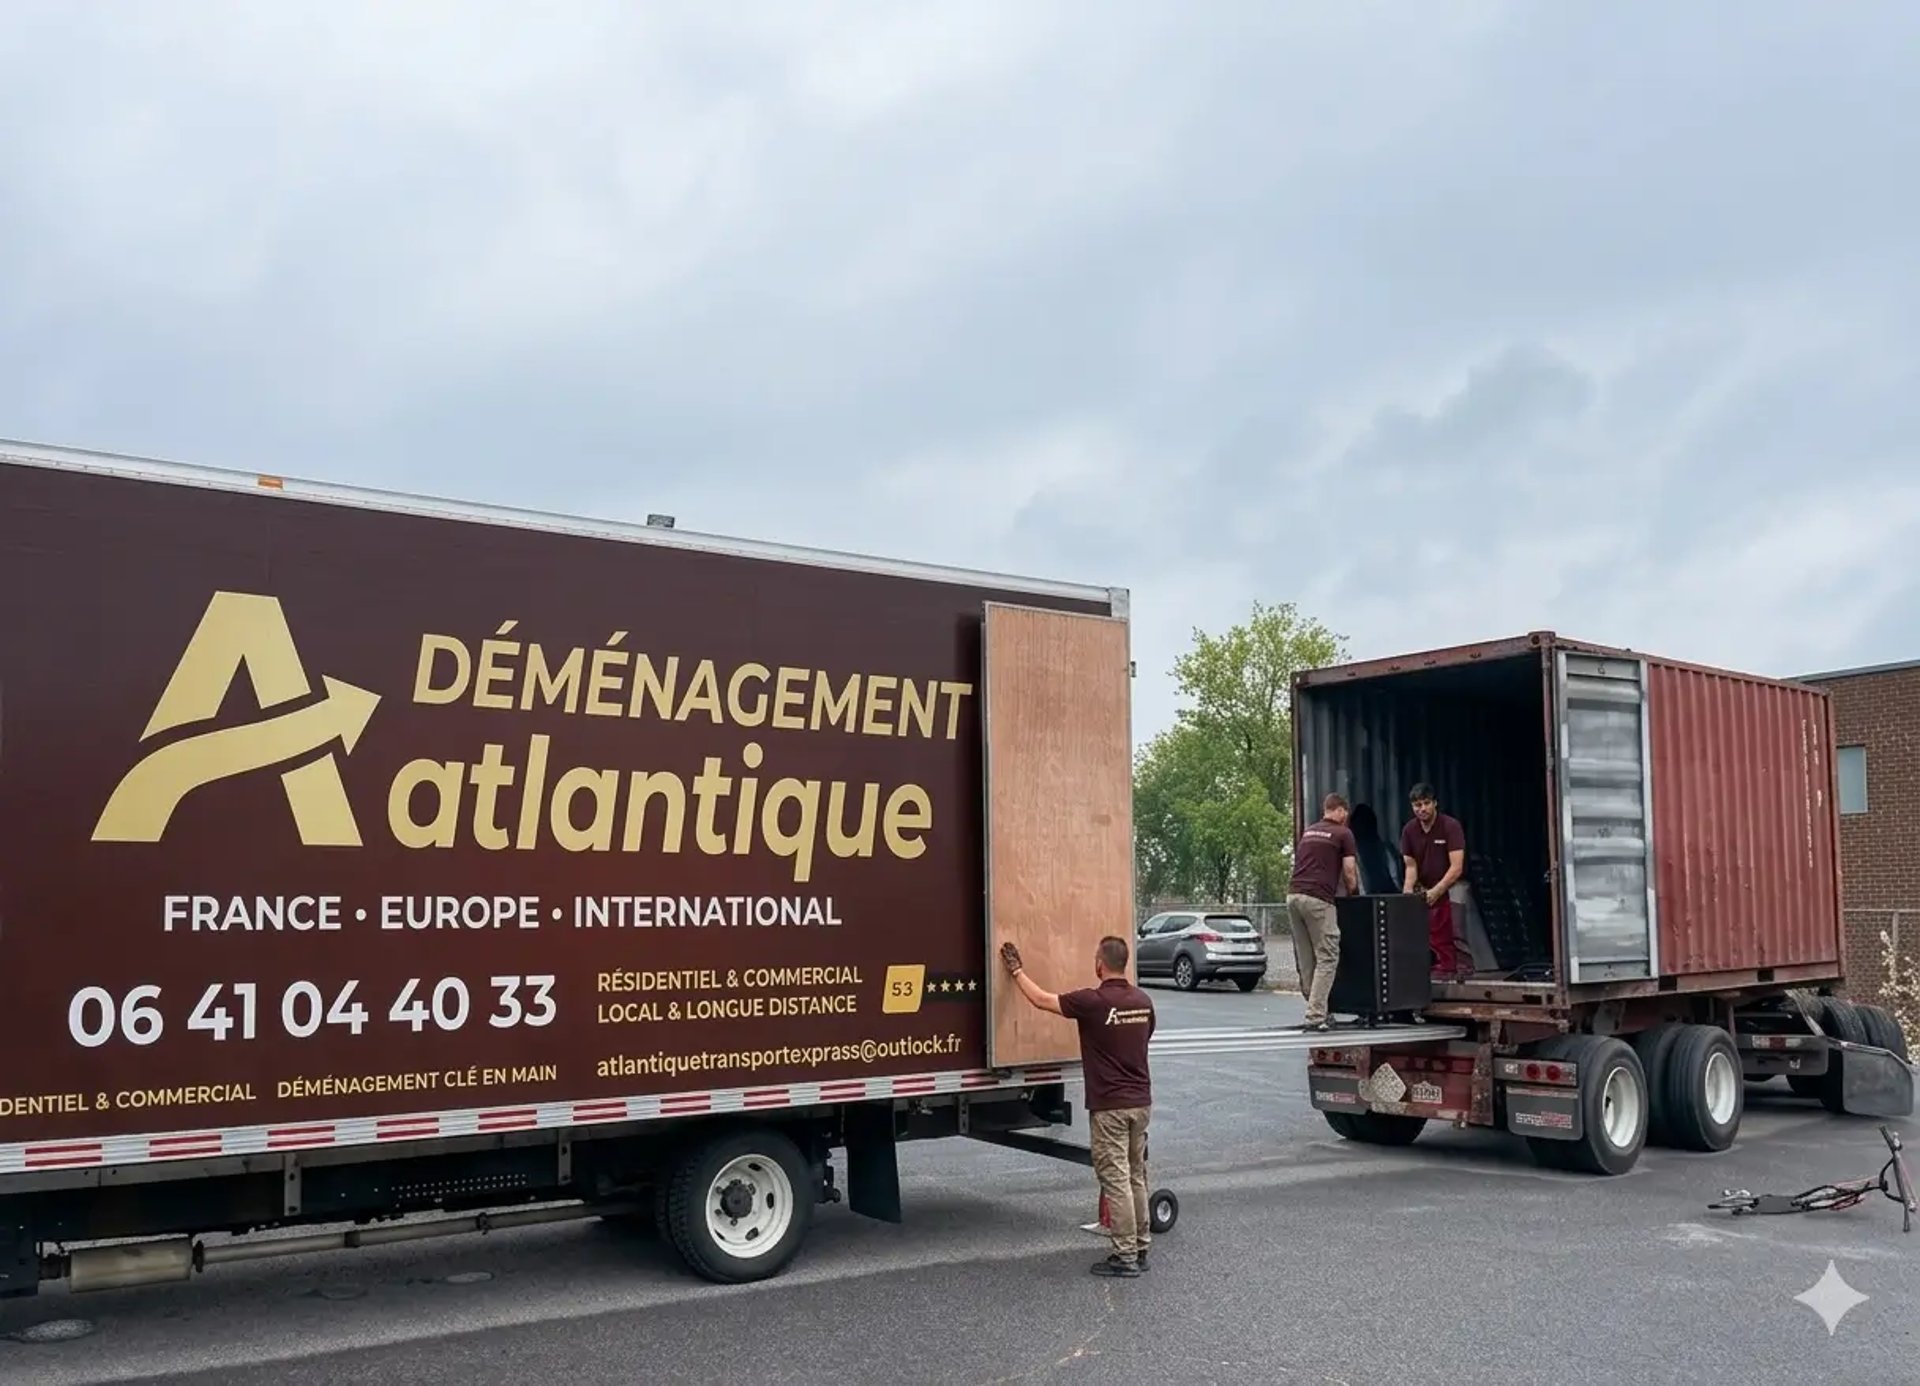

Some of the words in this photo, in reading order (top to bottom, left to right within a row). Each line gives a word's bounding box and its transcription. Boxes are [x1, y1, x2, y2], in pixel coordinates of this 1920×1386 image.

[413, 620, 973, 740] DÉMÉNAGEMENT
[387, 733, 933, 883] atlantique
[163, 895, 342, 932] FRANCE
[381, 895, 540, 930] EUROPE
[574, 896, 843, 928] INTERNATIONAL
[597, 967, 723, 993] RÉSIDENTIEL
[726, 969, 740, 988] &
[743, 965, 863, 988] COMMERCIAL
[891, 981, 913, 997] 53
[68, 984, 164, 1048] 06
[187, 982, 258, 1041] 41
[281, 979, 369, 1039] 04
[388, 977, 470, 1033] 40
[488, 974, 557, 1029] 33
[597, 1002, 664, 1024] LOCAL
[667, 1001, 682, 1021] &
[686, 998, 764, 1020] LONGUE
[769, 994, 858, 1016] DISTANCE
[277, 1071, 440, 1098] DÉMÉNAGEMENT
[444, 1065, 478, 1088] CLÉ
[482, 1067, 507, 1086] EN
[511, 1064, 558, 1083] MAIN
[0, 1093, 90, 1117] DENTIEL
[95, 1092, 110, 1110] &
[116, 1083, 257, 1109] COMMERCIAL
